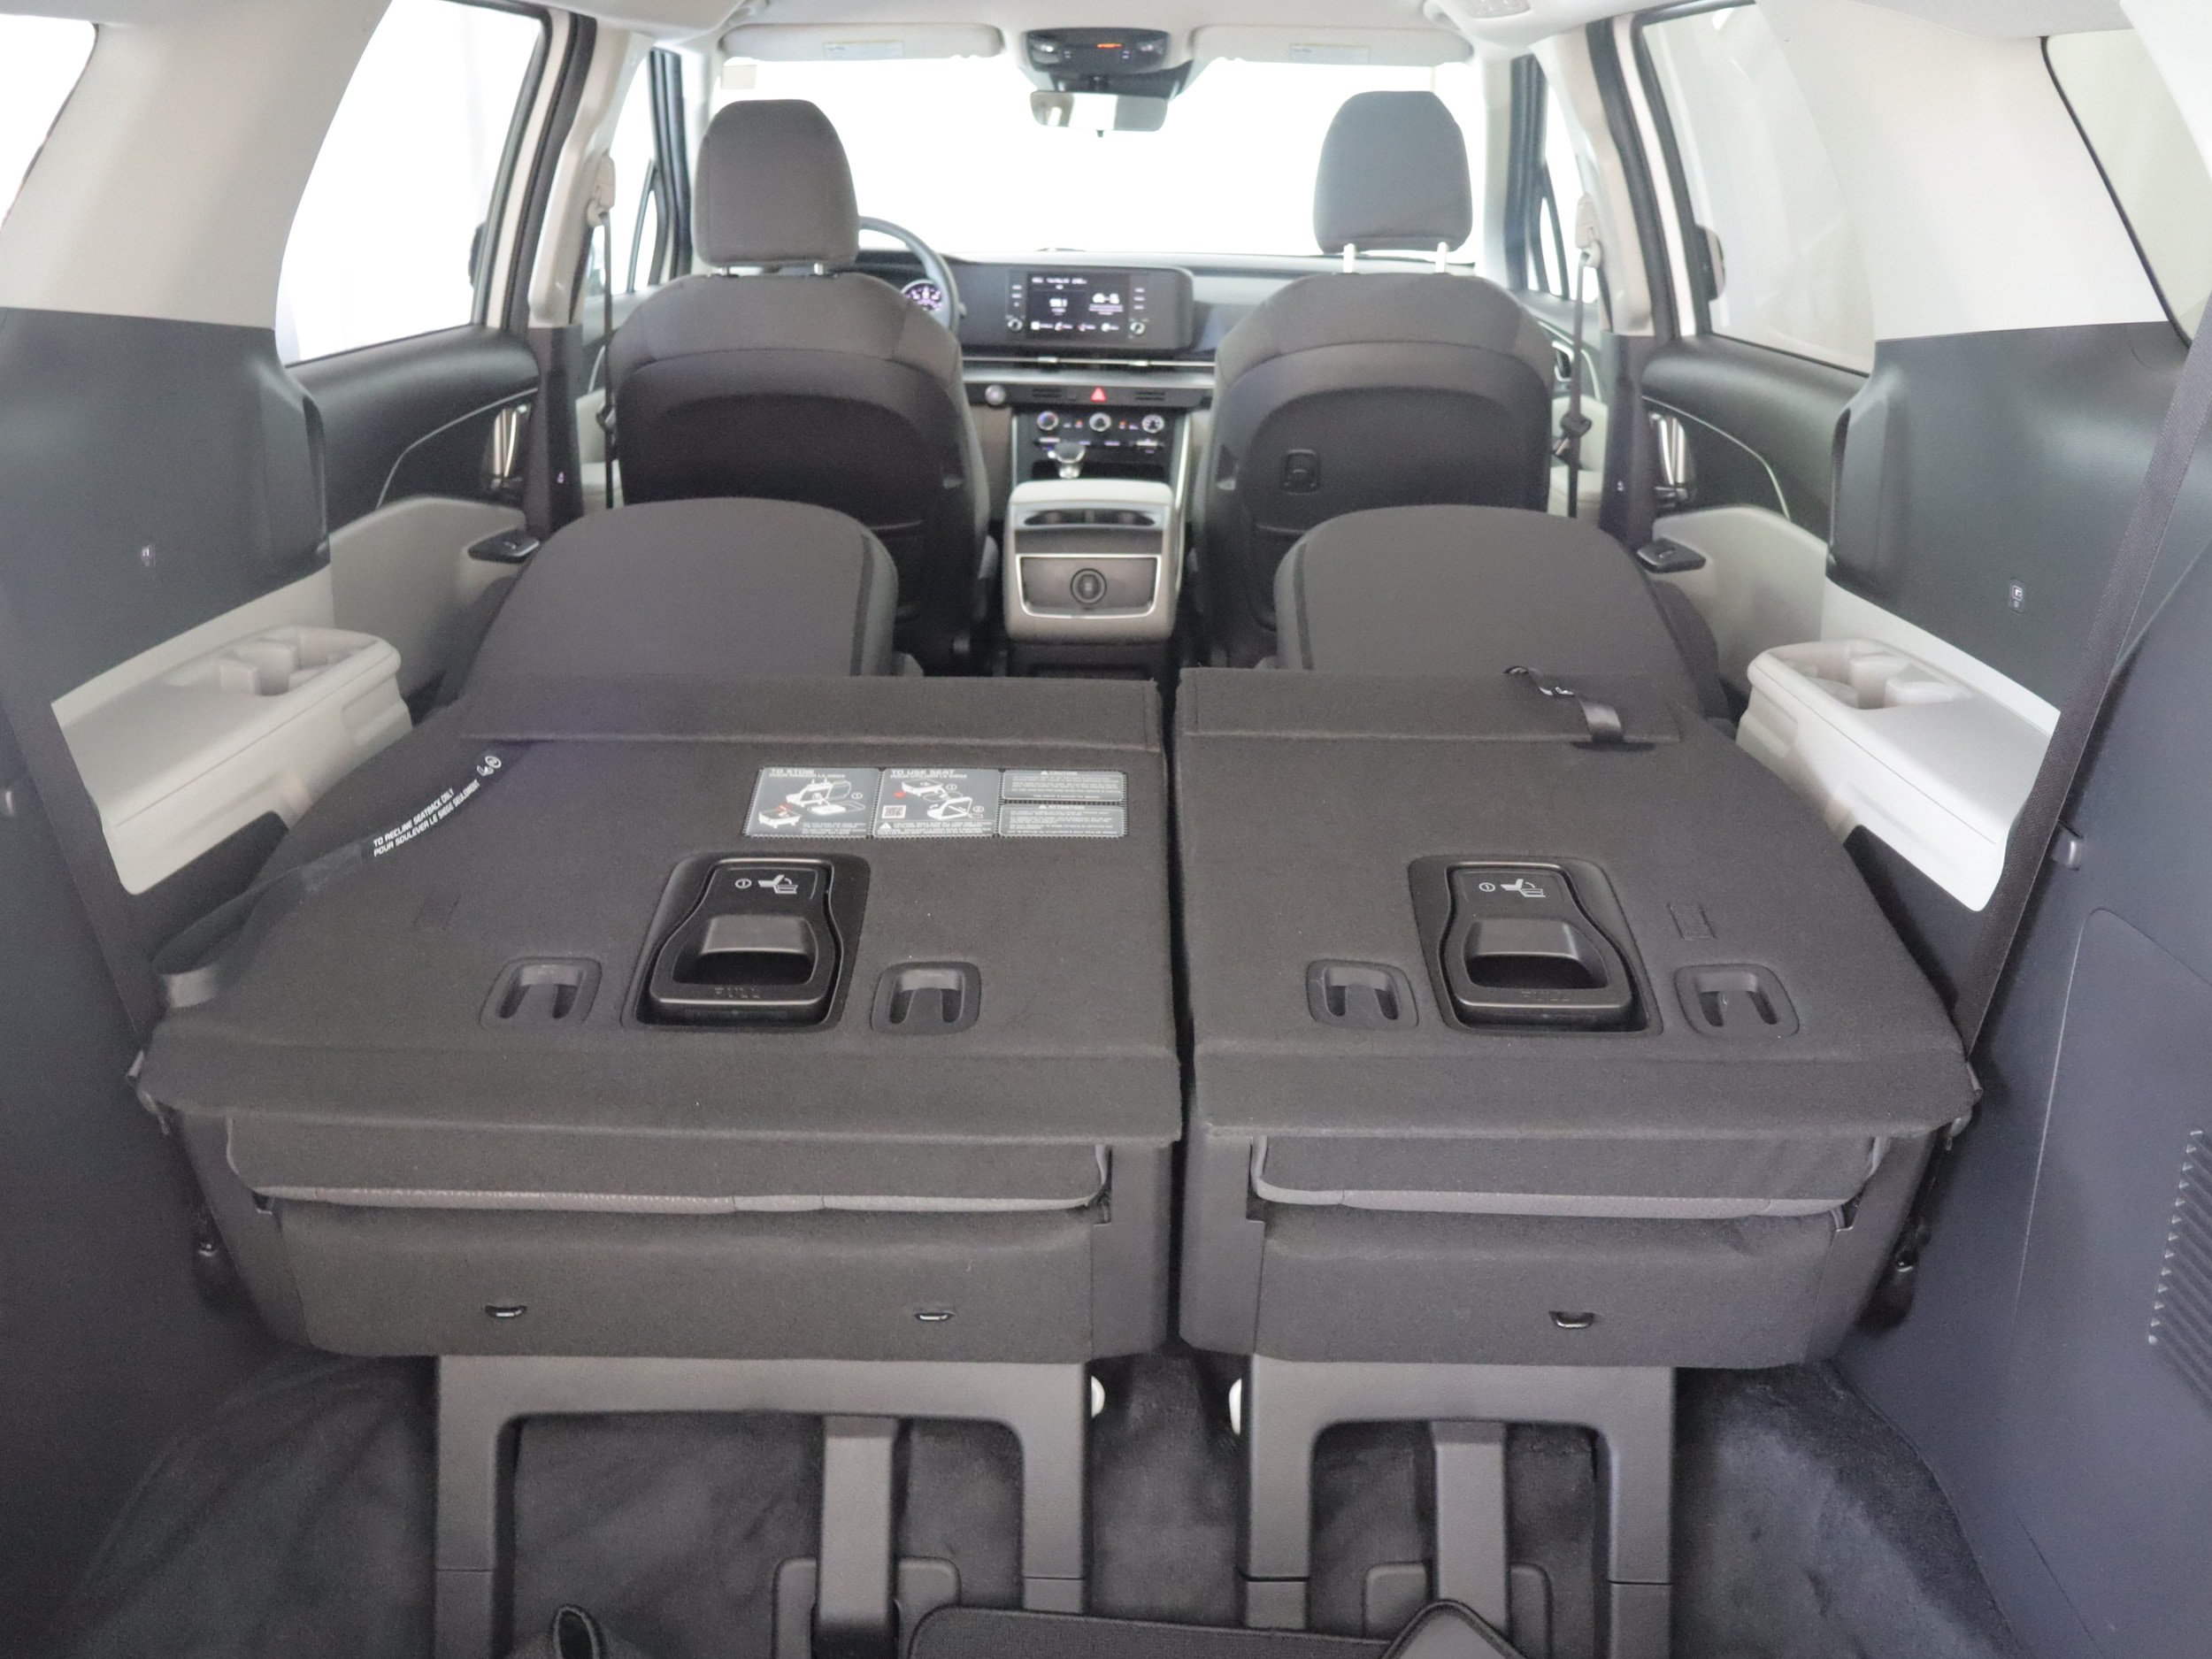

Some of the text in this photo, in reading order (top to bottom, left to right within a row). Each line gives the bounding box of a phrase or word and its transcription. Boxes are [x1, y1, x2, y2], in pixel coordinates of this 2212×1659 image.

[373, 787, 455, 848] TO RECLINE SEATBACK ONLY
[373, 841, 395, 857] POUR
[396, 821, 430, 847] SOULEVER
[429, 815, 439, 826] LE
